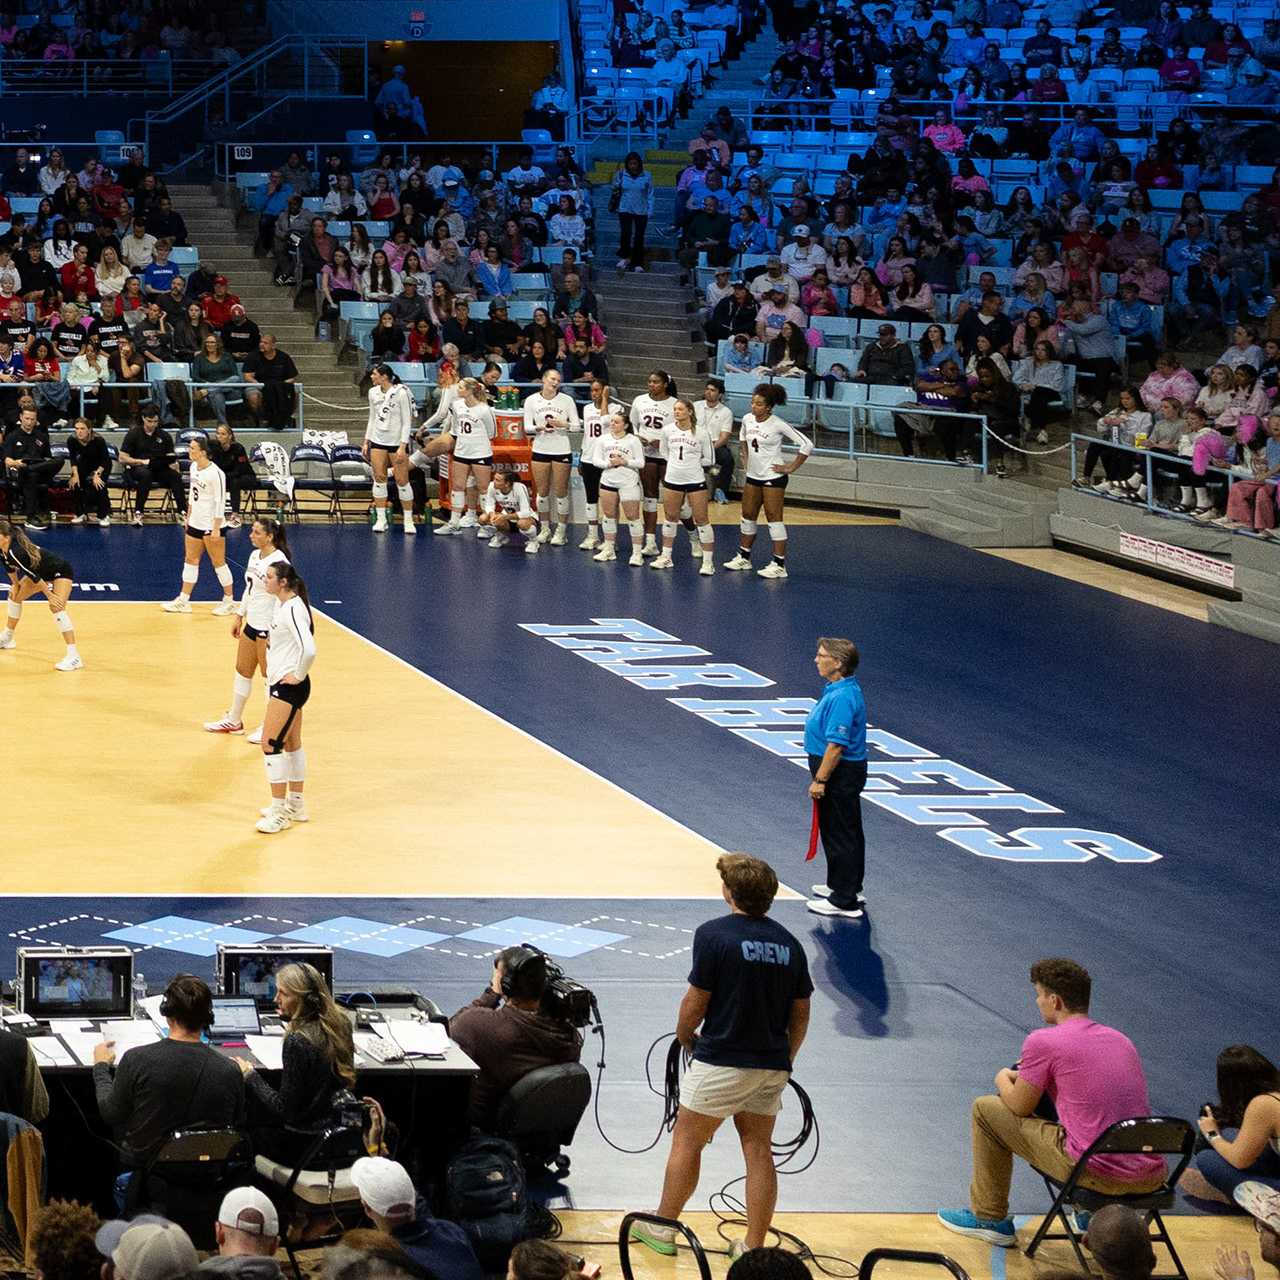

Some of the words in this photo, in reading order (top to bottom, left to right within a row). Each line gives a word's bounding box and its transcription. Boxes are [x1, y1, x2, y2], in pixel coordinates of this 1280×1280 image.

[235, 147, 251, 159] 109
[508, 422, 519, 434] G
[643, 415, 664, 429] 25
[590, 423, 601, 437] 18
[751, 438, 759, 453] 4
[678, 446, 684, 460] 1
[517, 618, 777, 691] TAR
[741, 940, 791, 966] CREW
